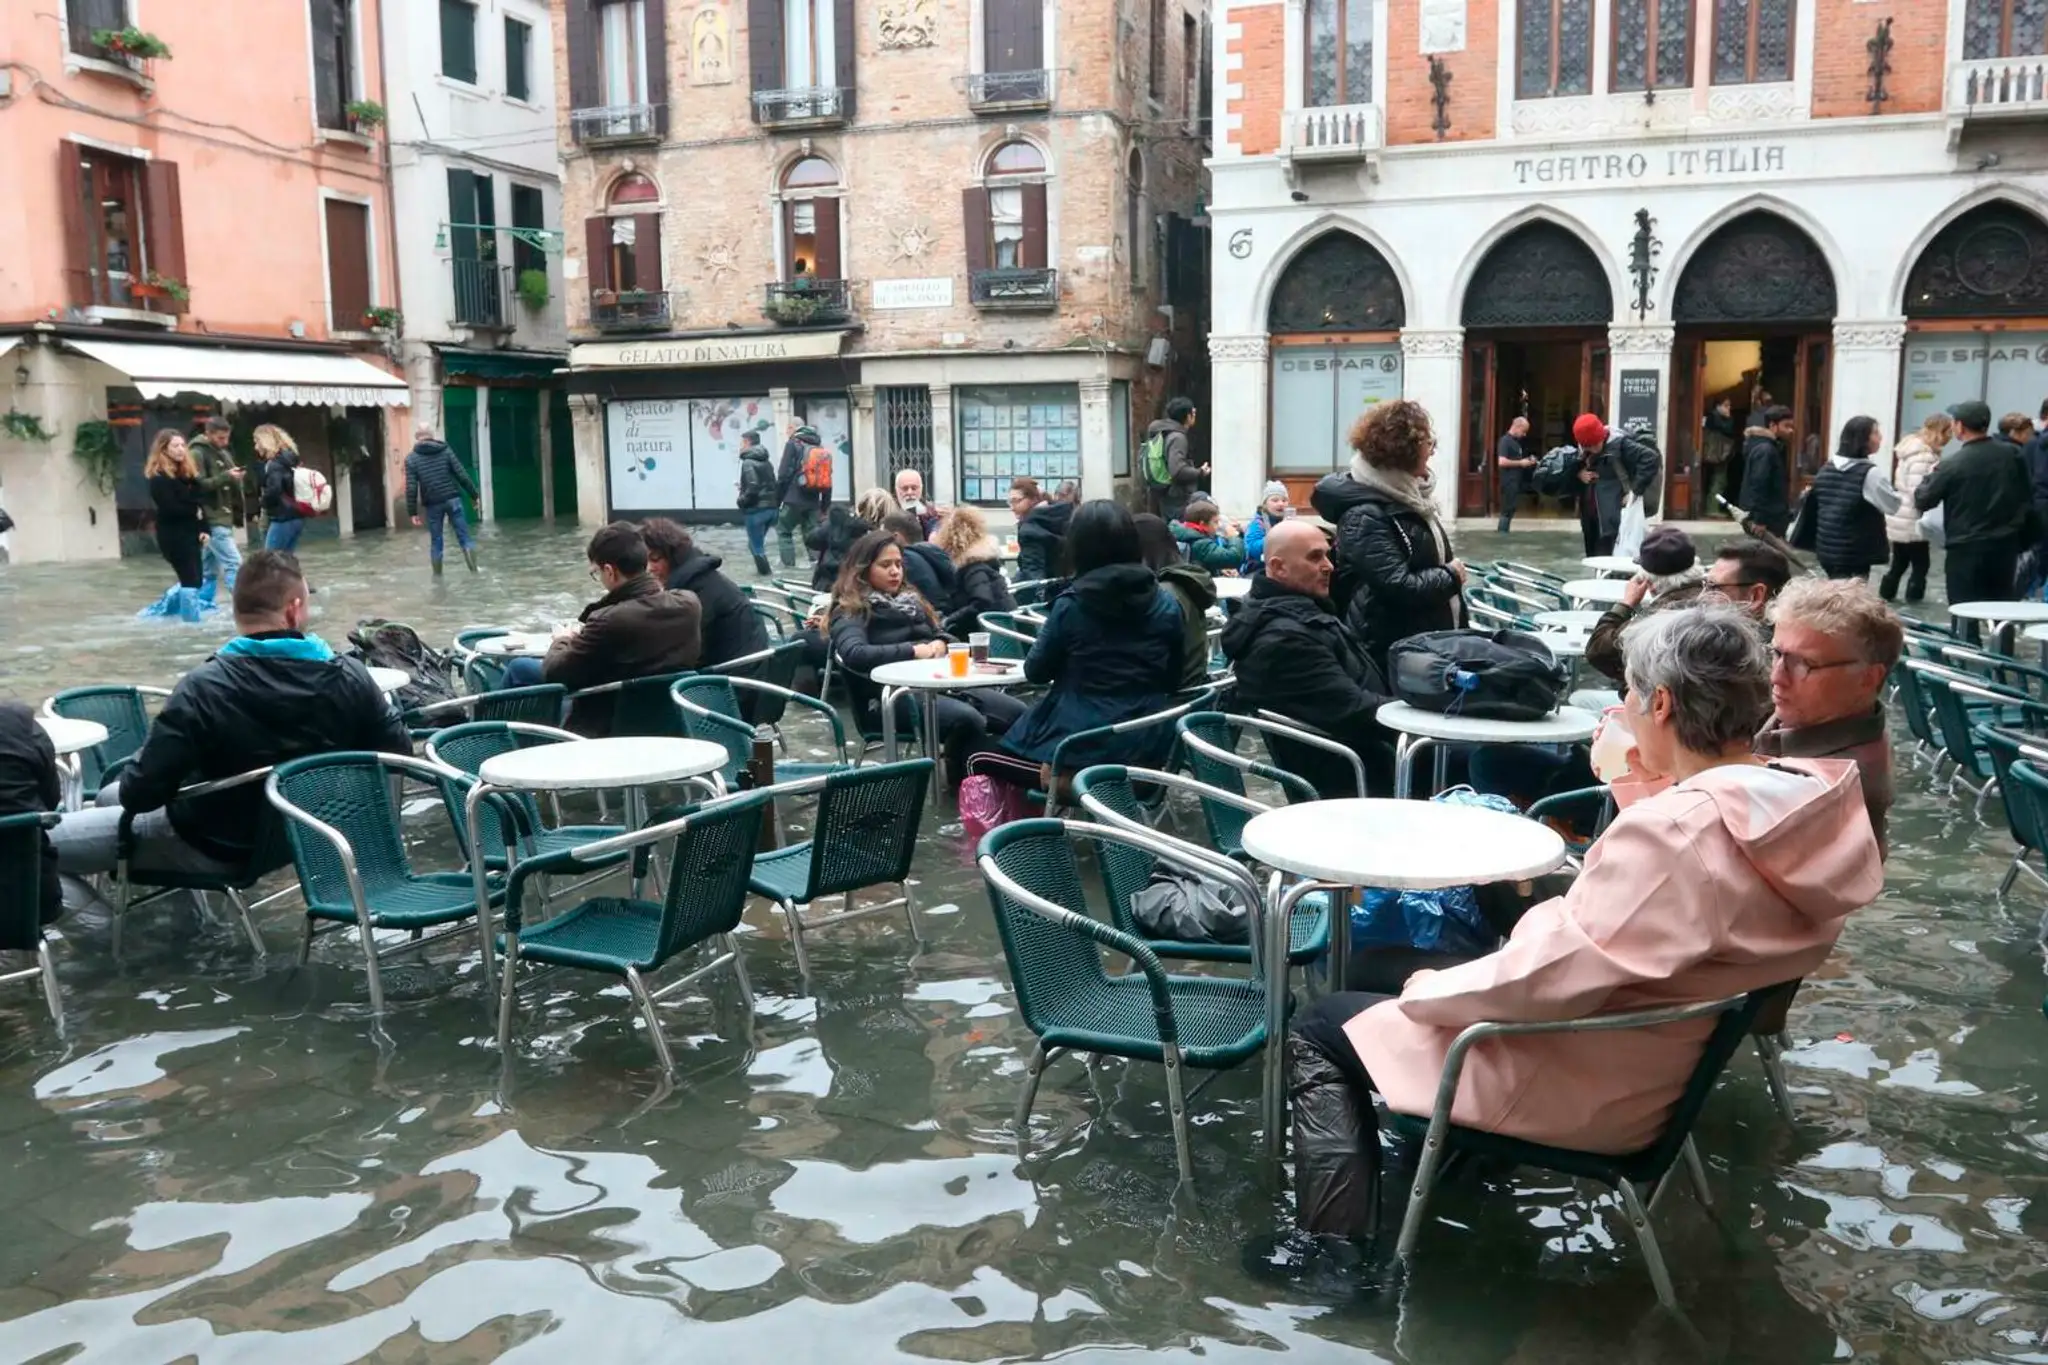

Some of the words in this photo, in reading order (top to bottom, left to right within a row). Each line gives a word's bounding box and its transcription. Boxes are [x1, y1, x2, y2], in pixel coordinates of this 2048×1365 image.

[1513, 153, 1648, 184] TEATRO
[1666, 145, 1786, 176] ITALIA
[619, 348, 689, 363] GELATO
[695, 346, 711, 361] DI
[716, 342, 788, 360] NATURA
[1910, 348, 2029, 364] DESPAR
[1282, 358, 1375, 372] DESPAR
[625, 419, 640, 438] di
[626, 440, 672, 453] natura
